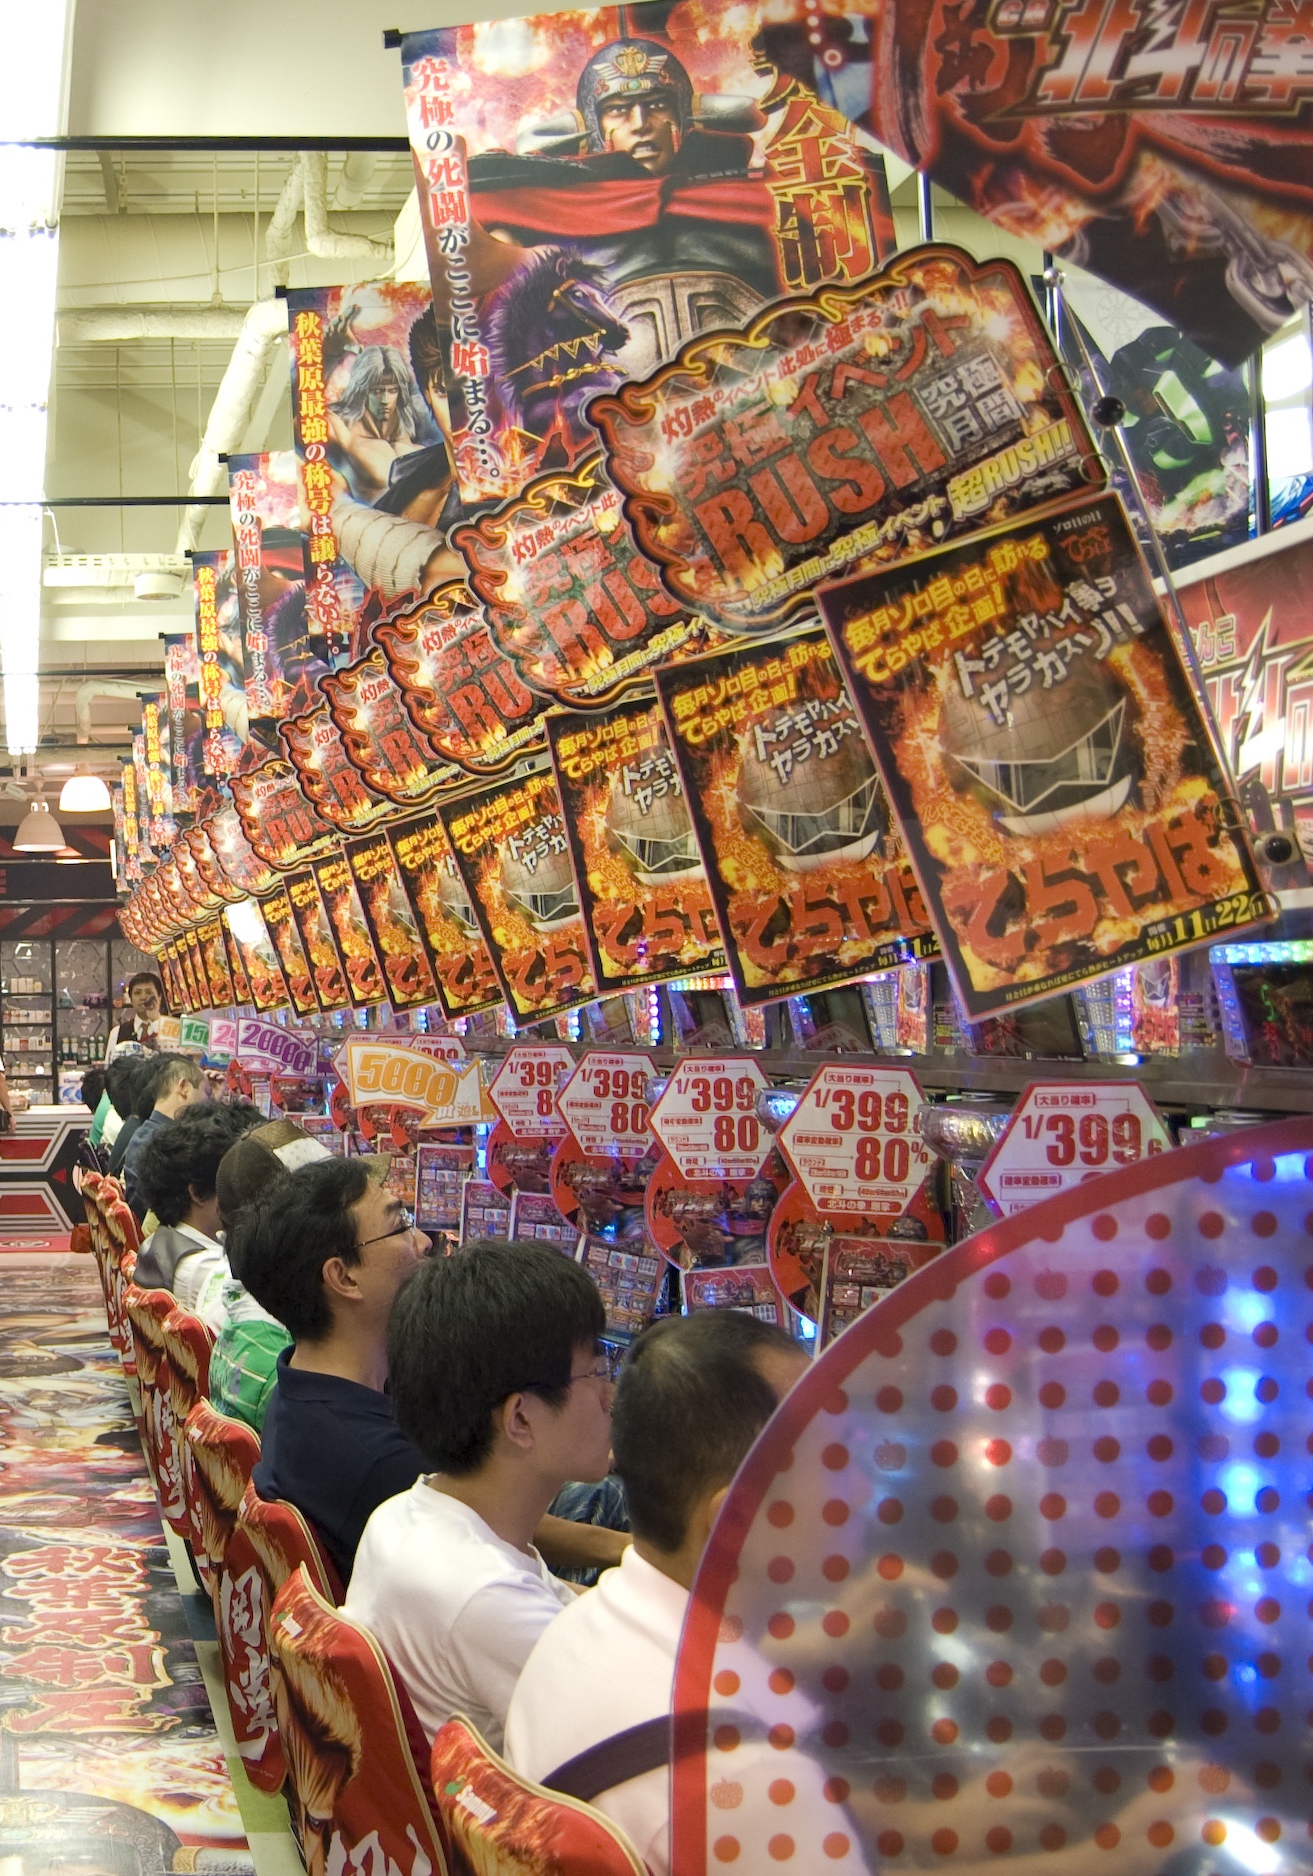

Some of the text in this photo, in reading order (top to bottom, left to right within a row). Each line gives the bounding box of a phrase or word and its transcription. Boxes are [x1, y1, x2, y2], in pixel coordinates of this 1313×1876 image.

[677, 308, 971, 499] 究極イベント
[922, 358, 1005, 419] 究極
[947, 393, 1022, 450] 月間
[695, 390, 949, 592] RUSH
[844, 532, 1050, 654] 毎月ゾロ目の日に訪れる
[854, 582, 1006, 685] てらやば 企画!
[954, 575, 1118, 698] トテモヤバイ事ヲ
[980, 604, 1146, 727] ヤラカスゾ!!
[671, 640, 831, 718] 毎月ゾロ目の日に訪れる
[678, 676, 797, 744] てらやば 企画!
[561, 727, 660, 779] てらやば 企画!
[241, 1024, 313, 1074] 20000
[356, 1051, 457, 1107] 5000
[828, 1074, 871, 1083] 大当り確率
[1039, 1094, 1093, 1106] 大当り確率
